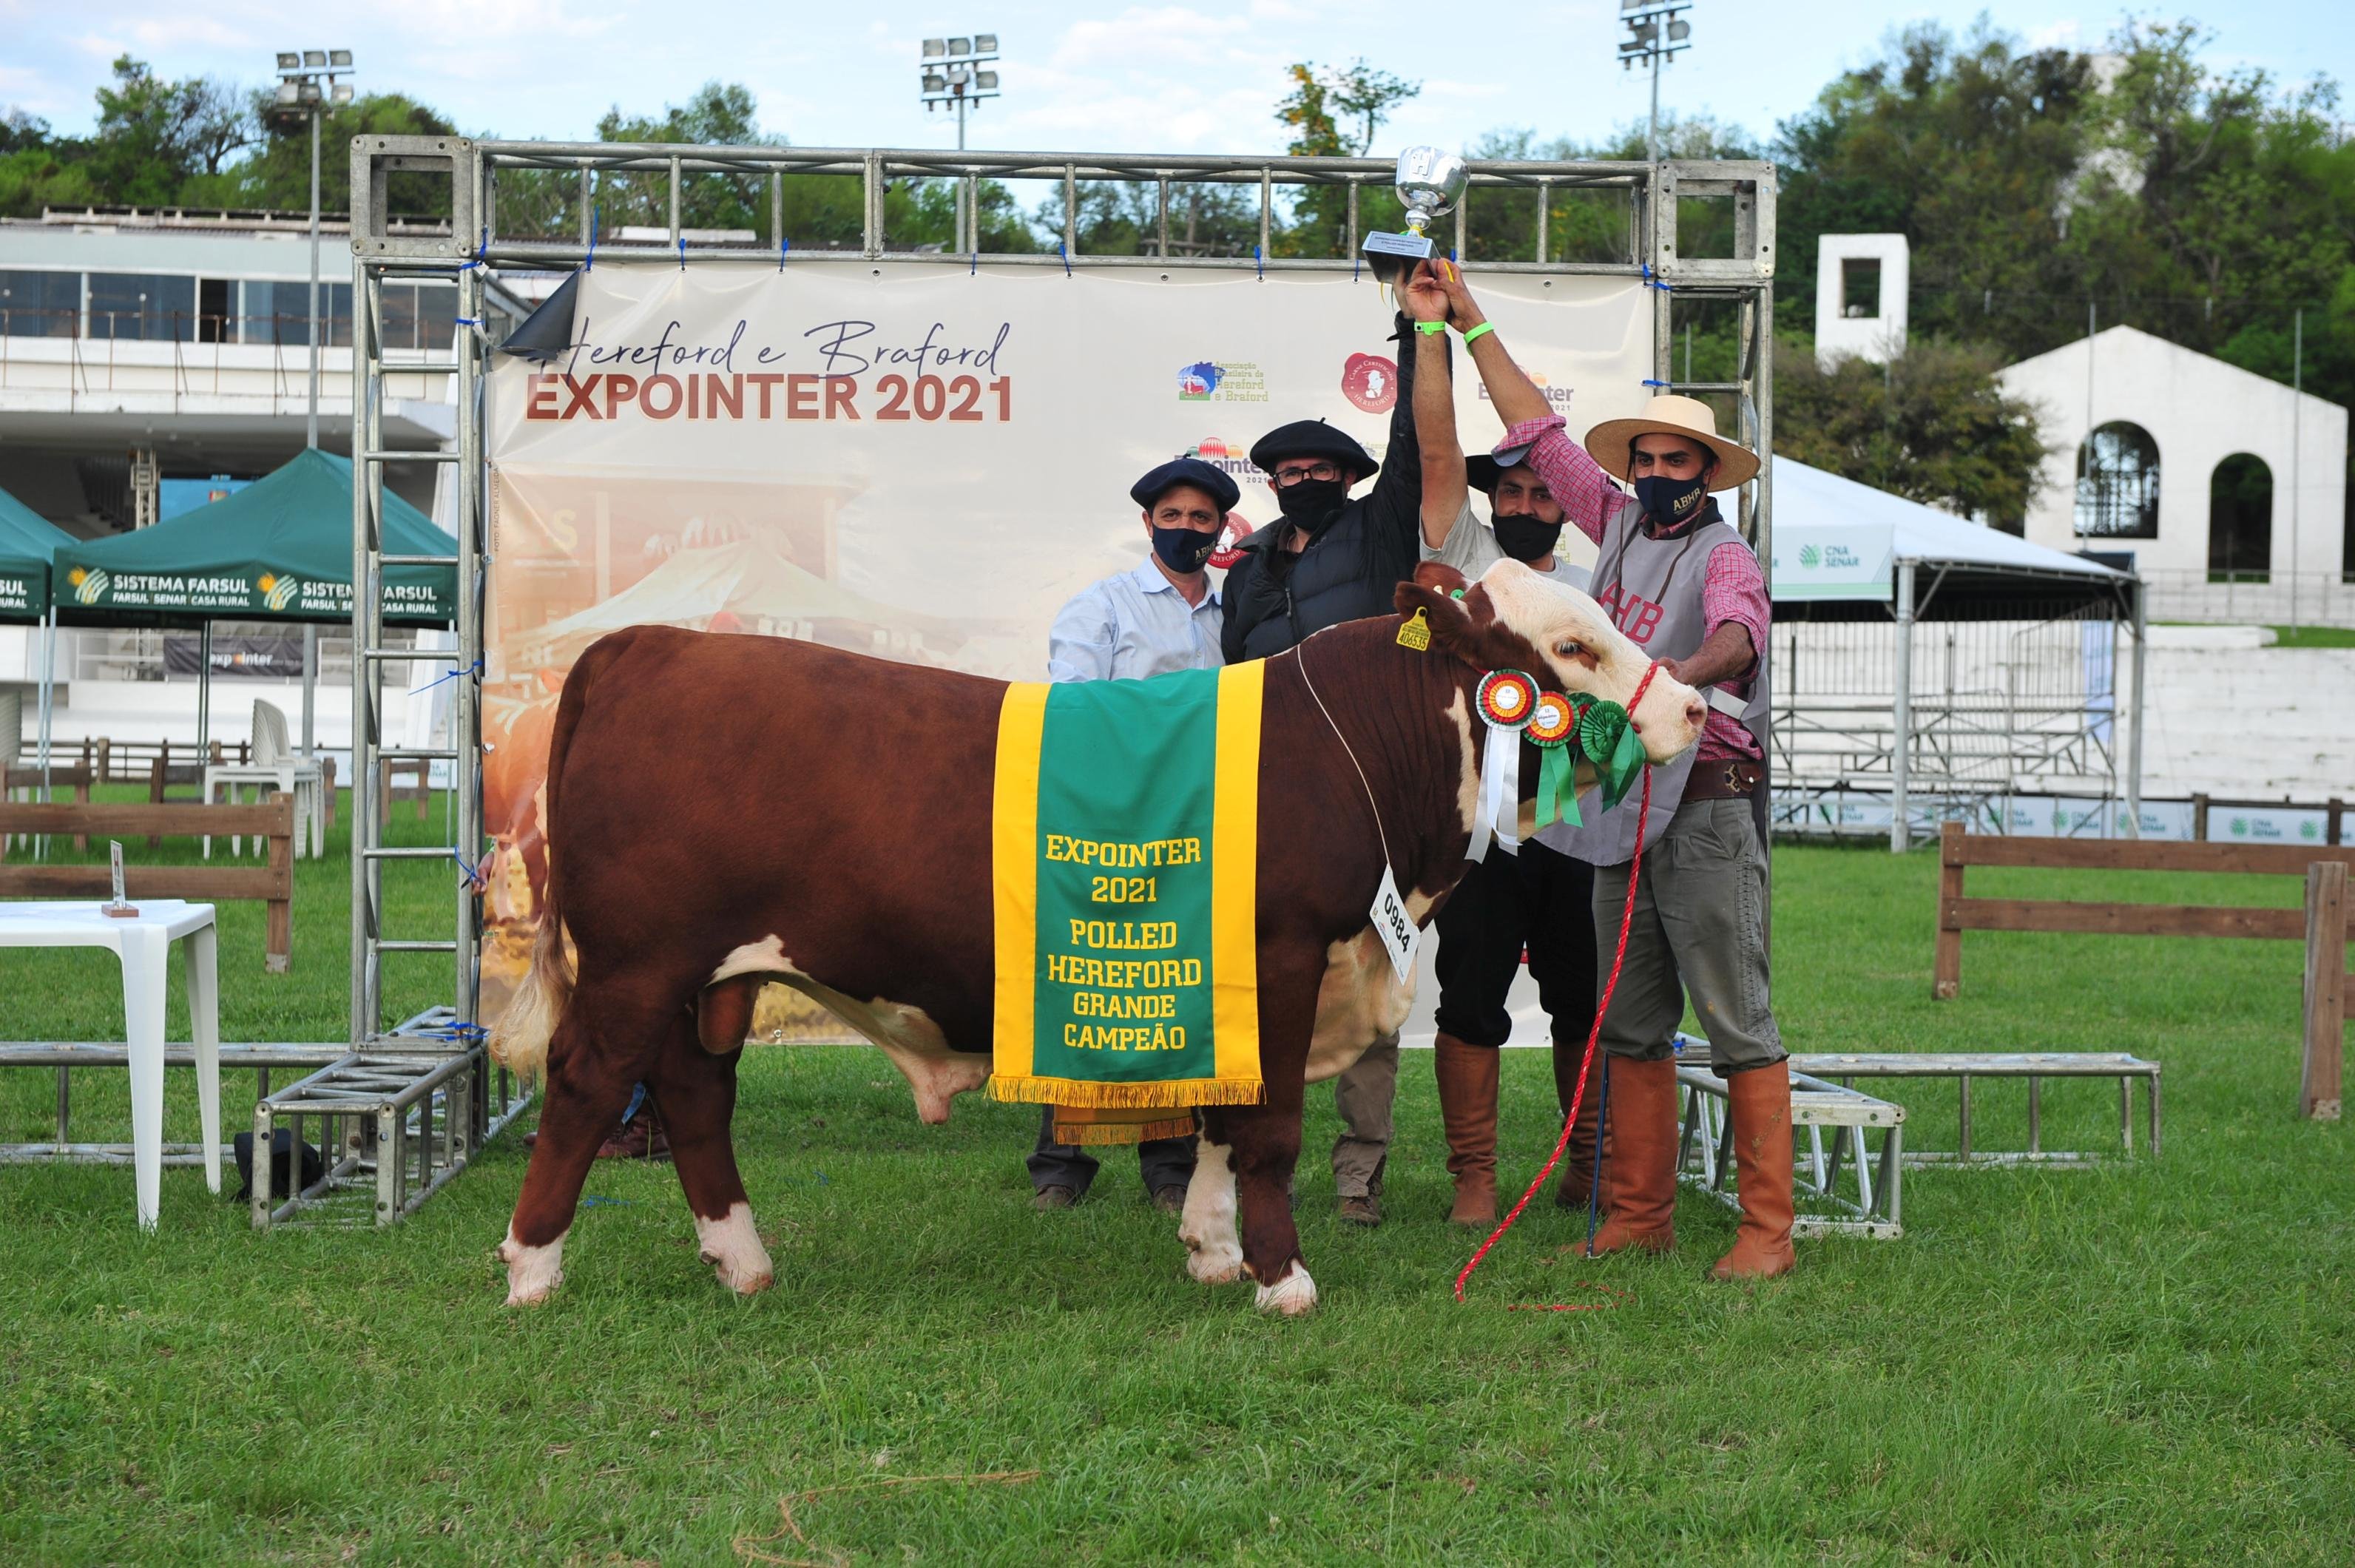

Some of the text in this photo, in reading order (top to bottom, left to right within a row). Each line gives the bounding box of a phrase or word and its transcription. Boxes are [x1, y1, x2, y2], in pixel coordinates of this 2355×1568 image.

[758, 346, 786, 363] e
[804, 320, 1010, 379] Braford
[525, 373, 1010, 422] EXPOINTER 2021
[1226, 391, 1268, 402] Braford
[1825, 545, 1849, 555] CNA
[1824, 557, 1859, 567] SENAR
[114, 575, 251, 594] SISTEMA FARSUL
[303, 581, 438, 601] SISTE ARSUL
[0, 597, 27, 609] URAL
[112, 591, 251, 607] FARSUL SENAR CASA RURAL
[300, 598, 337, 612] FARSUL
[406, 603, 438, 615] RURAL
[1399, 632, 1427, 649] 406535
[1045, 834, 1202, 868] EXPOINTER
[1091, 876, 1157, 904] 2021
[1070, 918, 1178, 950] POLLED
[1384, 892, 1411, 953] 0984
[1047, 954, 1202, 989] HEREFORD
[1072, 991, 1176, 1018] GRANDE
[1063, 1022, 1186, 1052] CAMPEÃO
